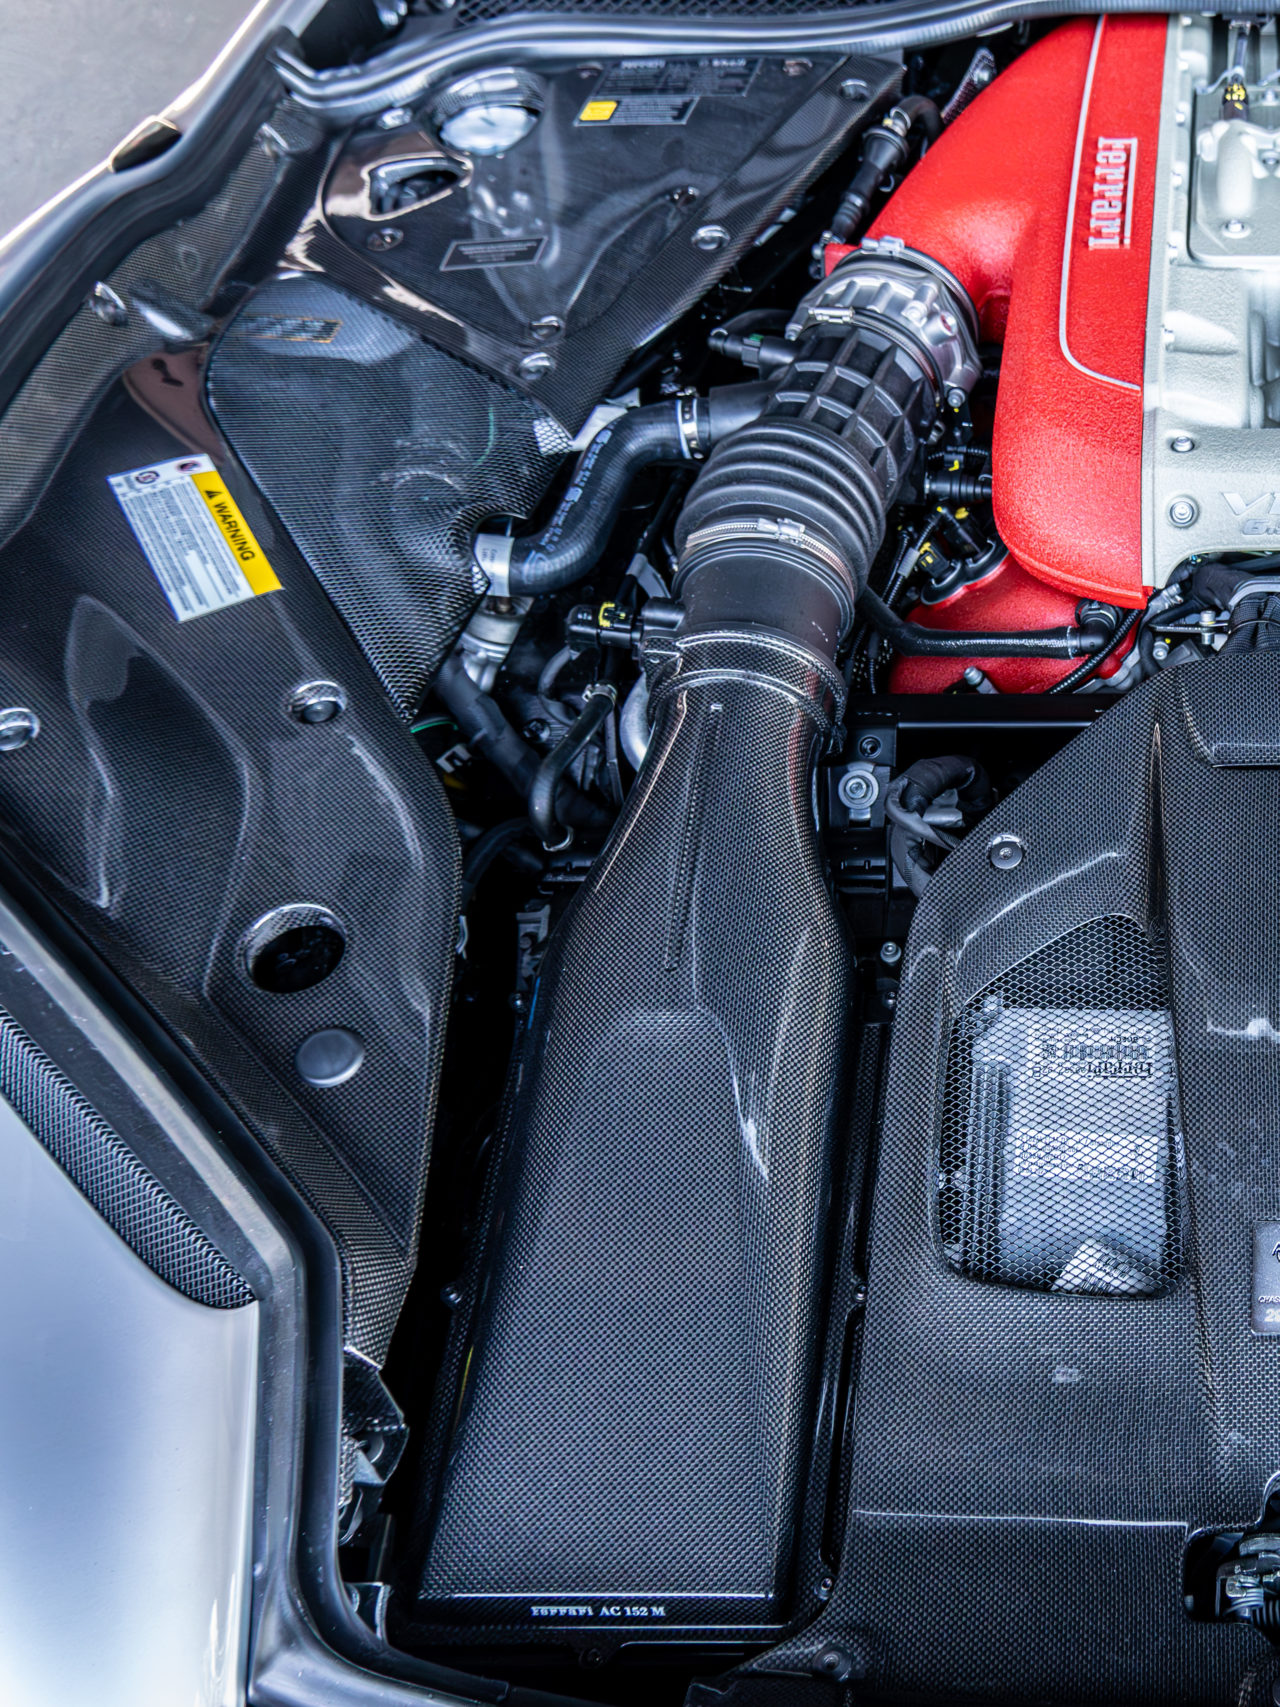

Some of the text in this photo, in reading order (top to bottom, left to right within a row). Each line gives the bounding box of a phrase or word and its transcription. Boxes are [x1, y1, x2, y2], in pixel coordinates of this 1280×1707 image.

[1088, 136, 1138, 250] Ferrari
[213, 501, 256, 561] WARNING
[530, 1606, 666, 1617] Ferrari AC 152 M
